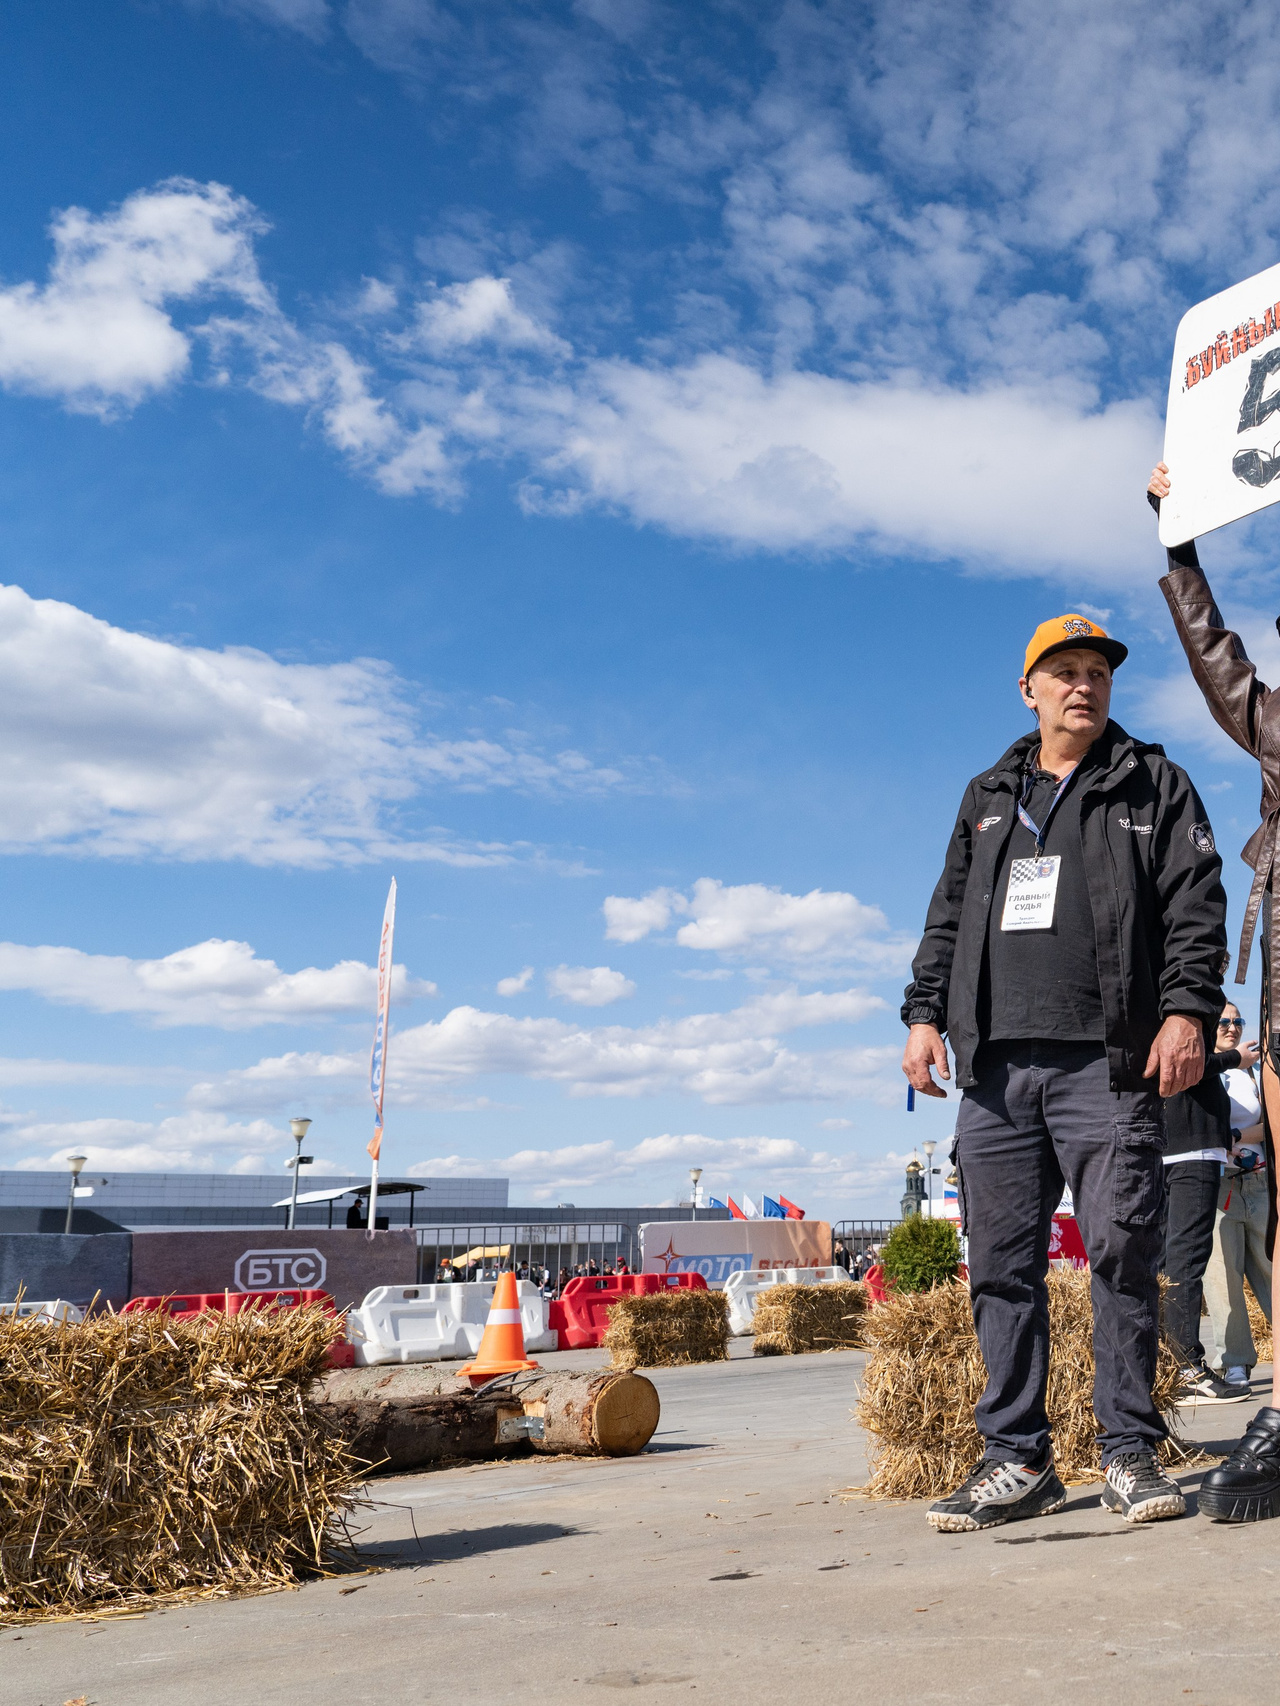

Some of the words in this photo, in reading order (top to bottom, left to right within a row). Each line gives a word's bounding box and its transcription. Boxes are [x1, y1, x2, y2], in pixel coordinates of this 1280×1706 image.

[1008, 891, 1051, 902] ГЛАВНЫЙ
[1014, 902, 1042, 911] СУДЬЯ
[247, 1257, 316, 1286] БТС
[676, 1257, 747, 1280] МОТО
